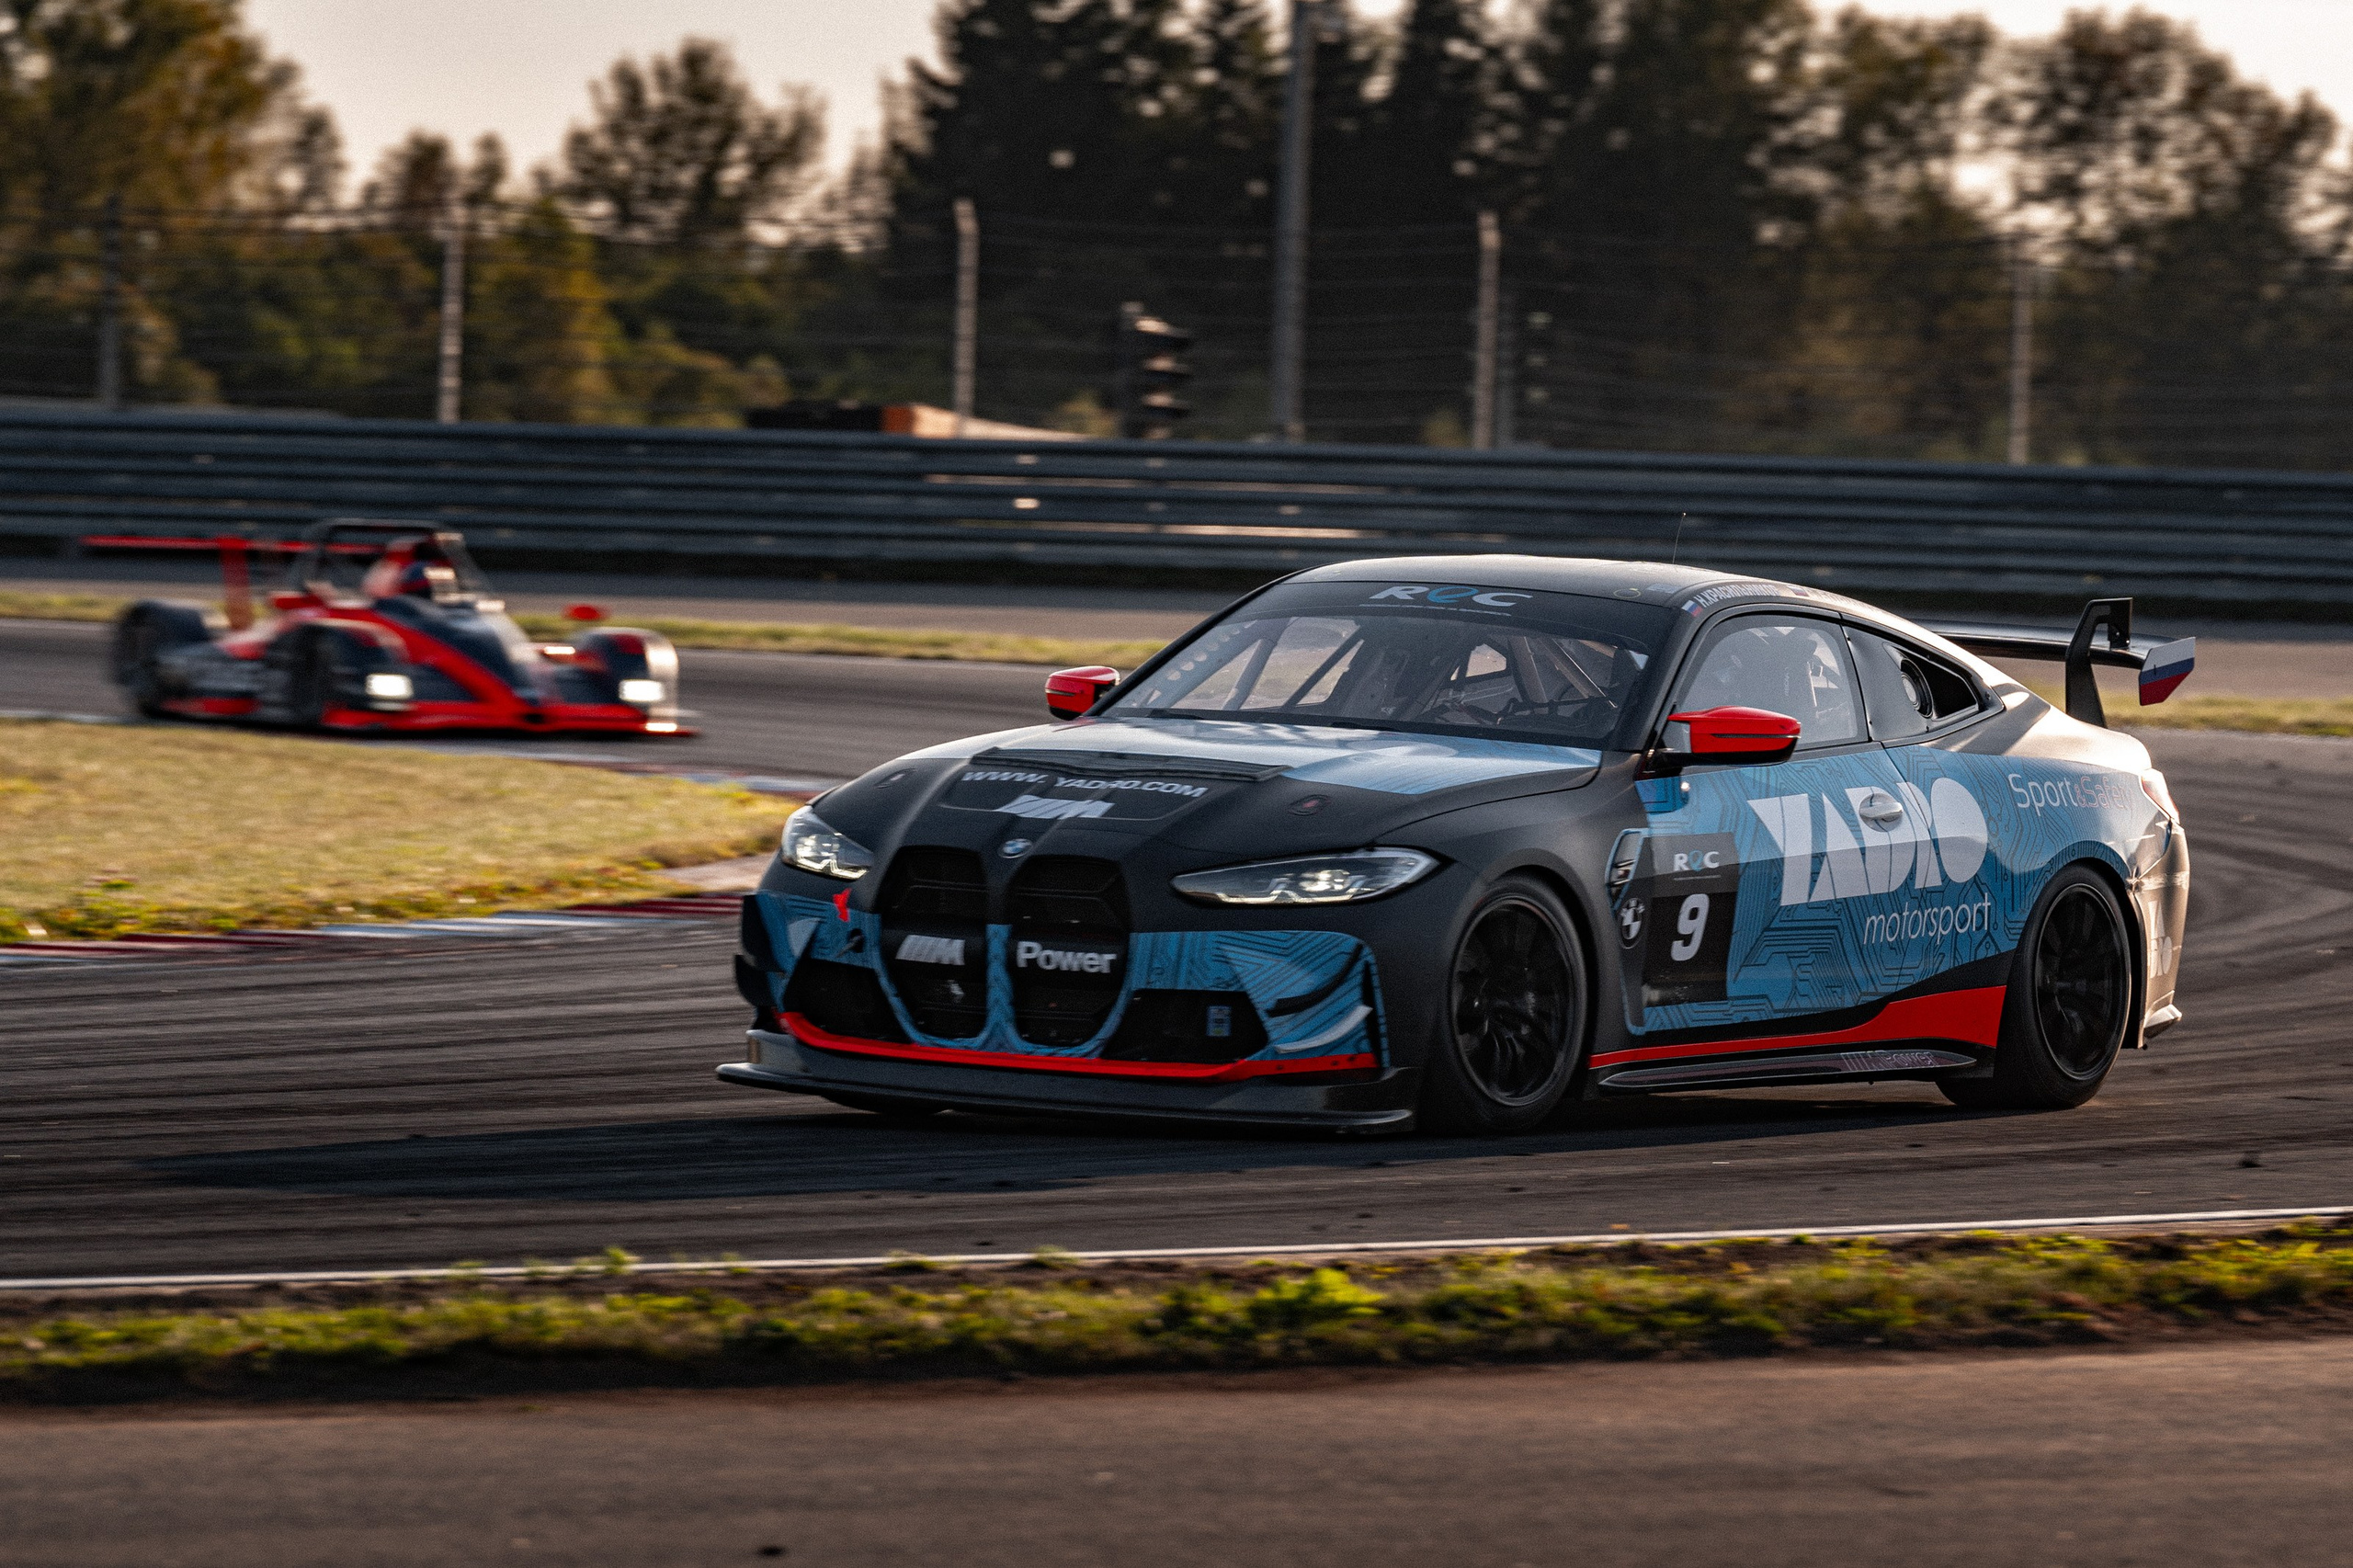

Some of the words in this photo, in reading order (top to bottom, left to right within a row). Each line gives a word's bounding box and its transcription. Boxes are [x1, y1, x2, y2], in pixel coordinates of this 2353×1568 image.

[1671, 893, 1710, 961] 9
[1864, 892, 1991, 945] motorsport
[1017, 940, 1117, 974] Power
